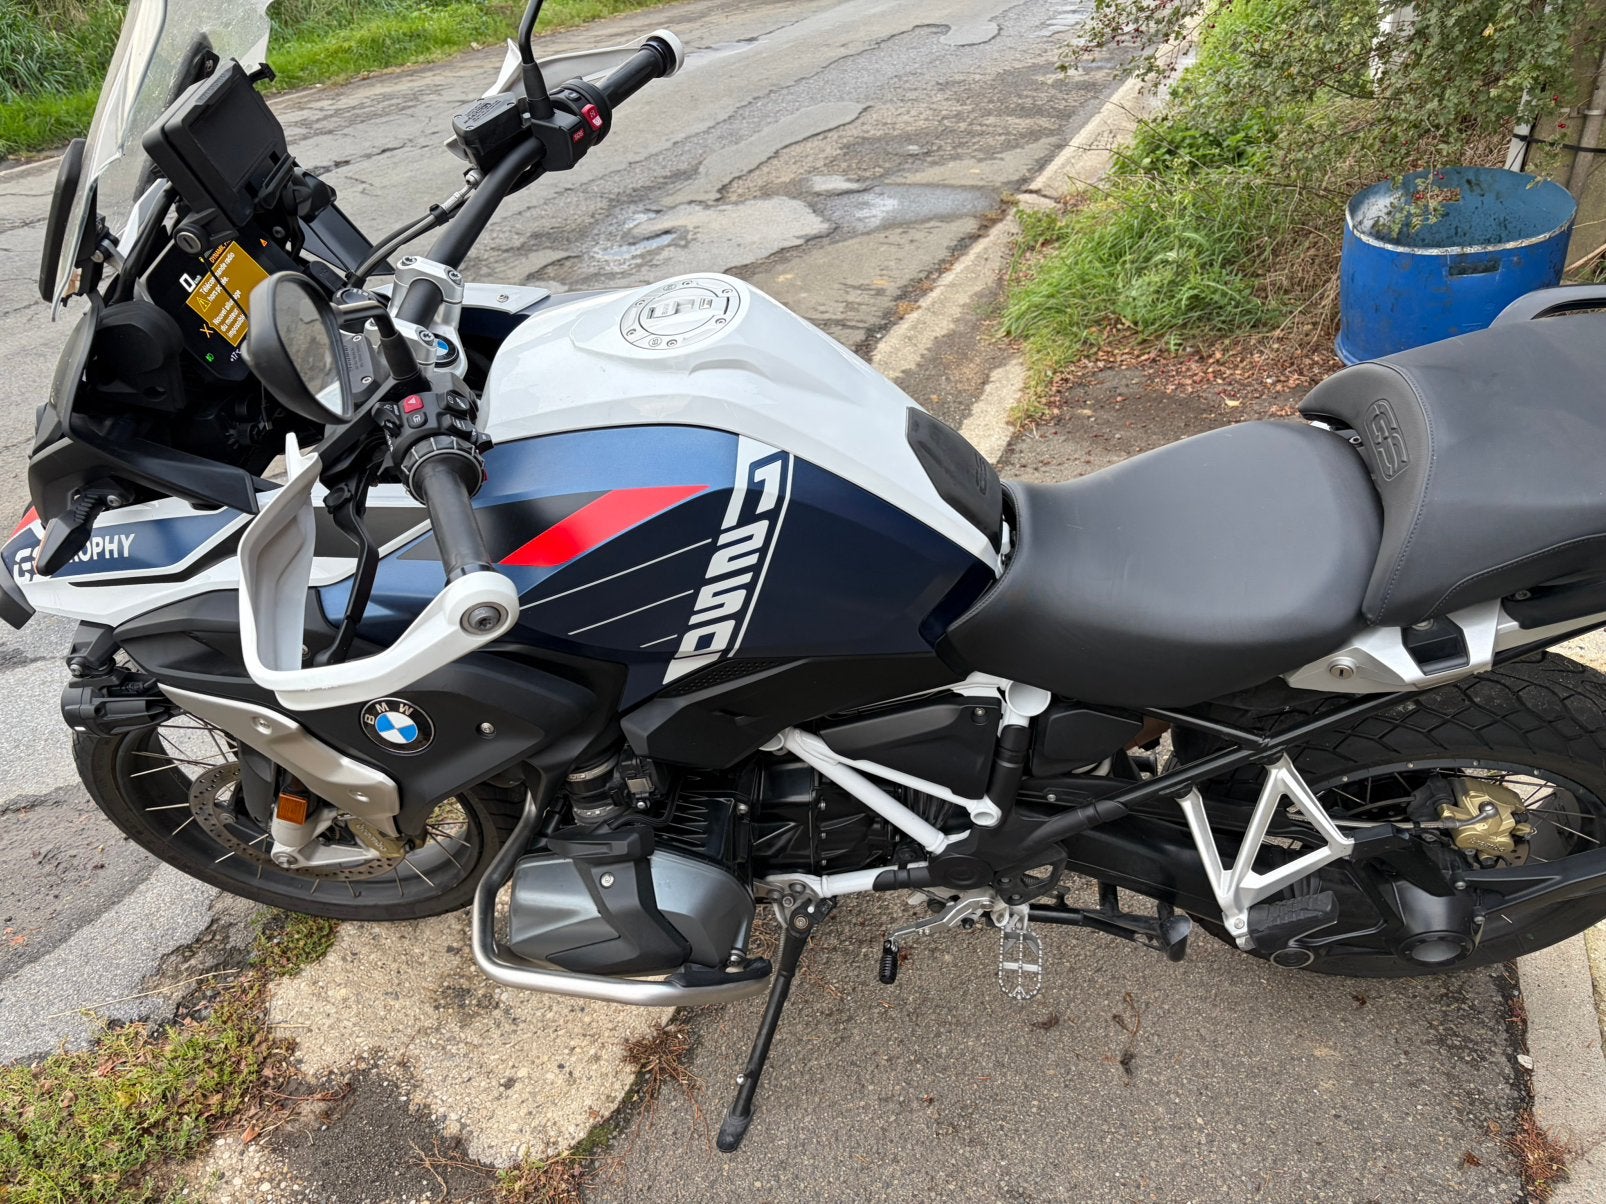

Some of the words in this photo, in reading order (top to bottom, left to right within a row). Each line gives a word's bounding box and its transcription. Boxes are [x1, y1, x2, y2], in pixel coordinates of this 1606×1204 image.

[179, 272, 197, 293] 0
[220, 323, 229, 332] du
[675, 459, 782, 659] 1250
[364, 701, 415, 726] BMW
